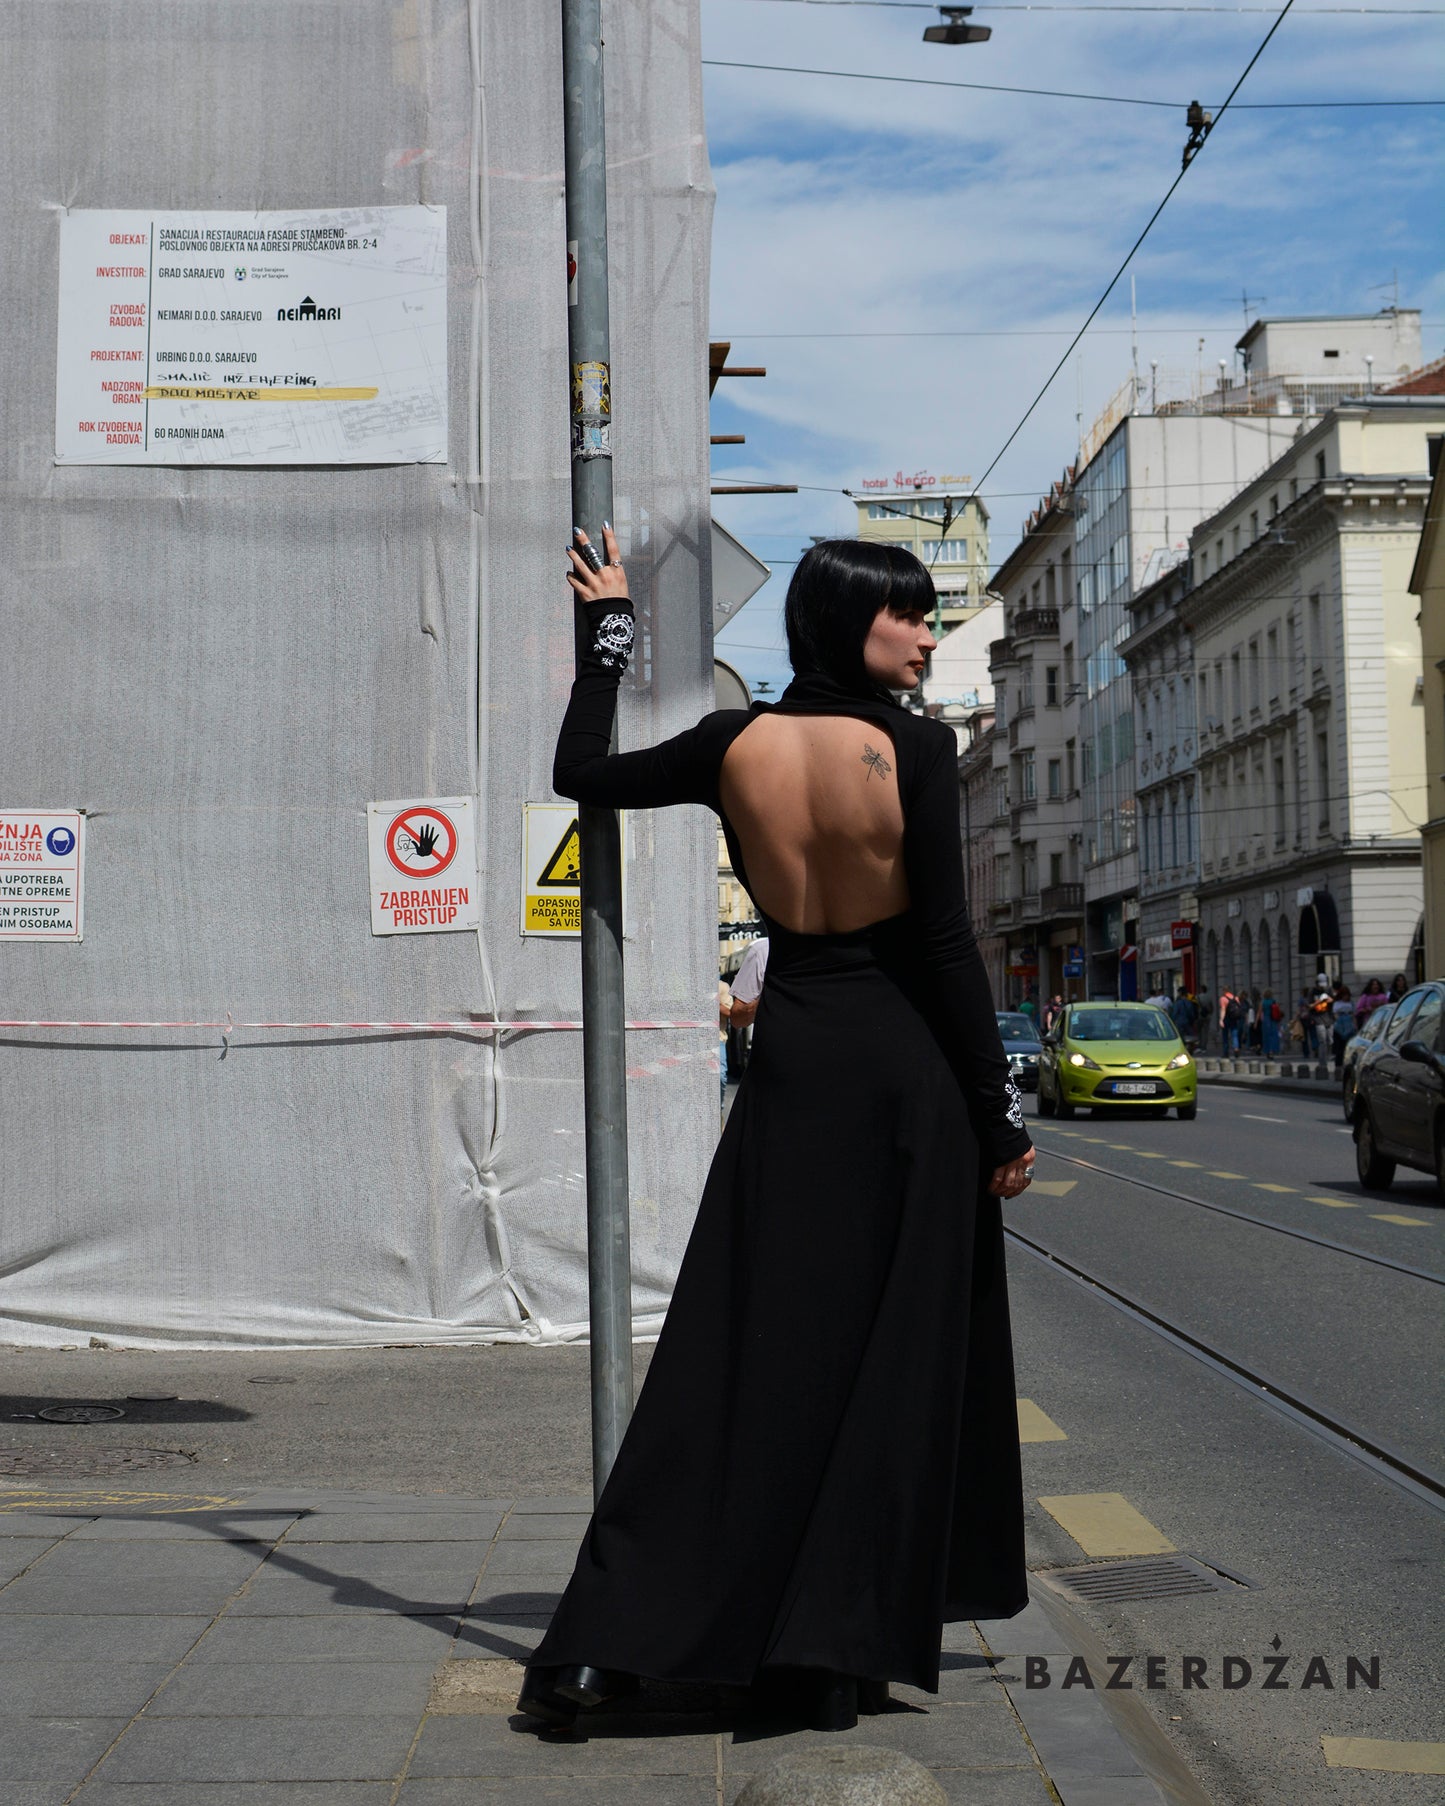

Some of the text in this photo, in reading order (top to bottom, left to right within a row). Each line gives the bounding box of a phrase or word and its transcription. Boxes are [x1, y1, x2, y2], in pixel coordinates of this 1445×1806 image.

[109, 234, 148, 245] OBJEKAT:
[159, 228, 348, 241] SANACIJA I RESTAURACIJA FASADE STAMBENO-
[159, 240, 208, 251] POSLOVNOG
[209, 240, 245, 252] OBJEKTA
[247, 241, 259, 251] NA
[260, 240, 291, 252] ADRESI
[347, 239, 361, 250] BR.
[362, 238, 378, 249] 2-4
[96, 266, 147, 278] INVESTITOR:
[158, 267, 225, 279] GRAD SARAJEVO
[157, 309, 262, 321] NEIMARI D.O.O. SARAJEVO
[109, 316, 145, 327] RADOVA:
[90, 350, 145, 362] PROJEKTANT:
[156, 352, 257, 363] URBING D.O.O. SARAJEVO
[101, 381, 144, 392] NADZORNI
[78, 421, 96, 432] ROK
[106, 433, 143, 444] RADOVA:
[154, 428, 225, 439] 60 RADNIH DANA
[13, 852, 43, 862] ZONA
[5, 875, 64, 885] UPOTREBA
[25, 887, 71, 897] OPREME
[380, 887, 470, 910] ZABRANJEN
[537, 898, 580, 908] OPASNO
[13, 907, 60, 917] PRISTUP
[393, 906, 458, 927] PRISTUP
[531, 908, 559, 917] PADA
[19, 919, 73, 929] OSOBAMA
[549, 918, 562, 927] SA
